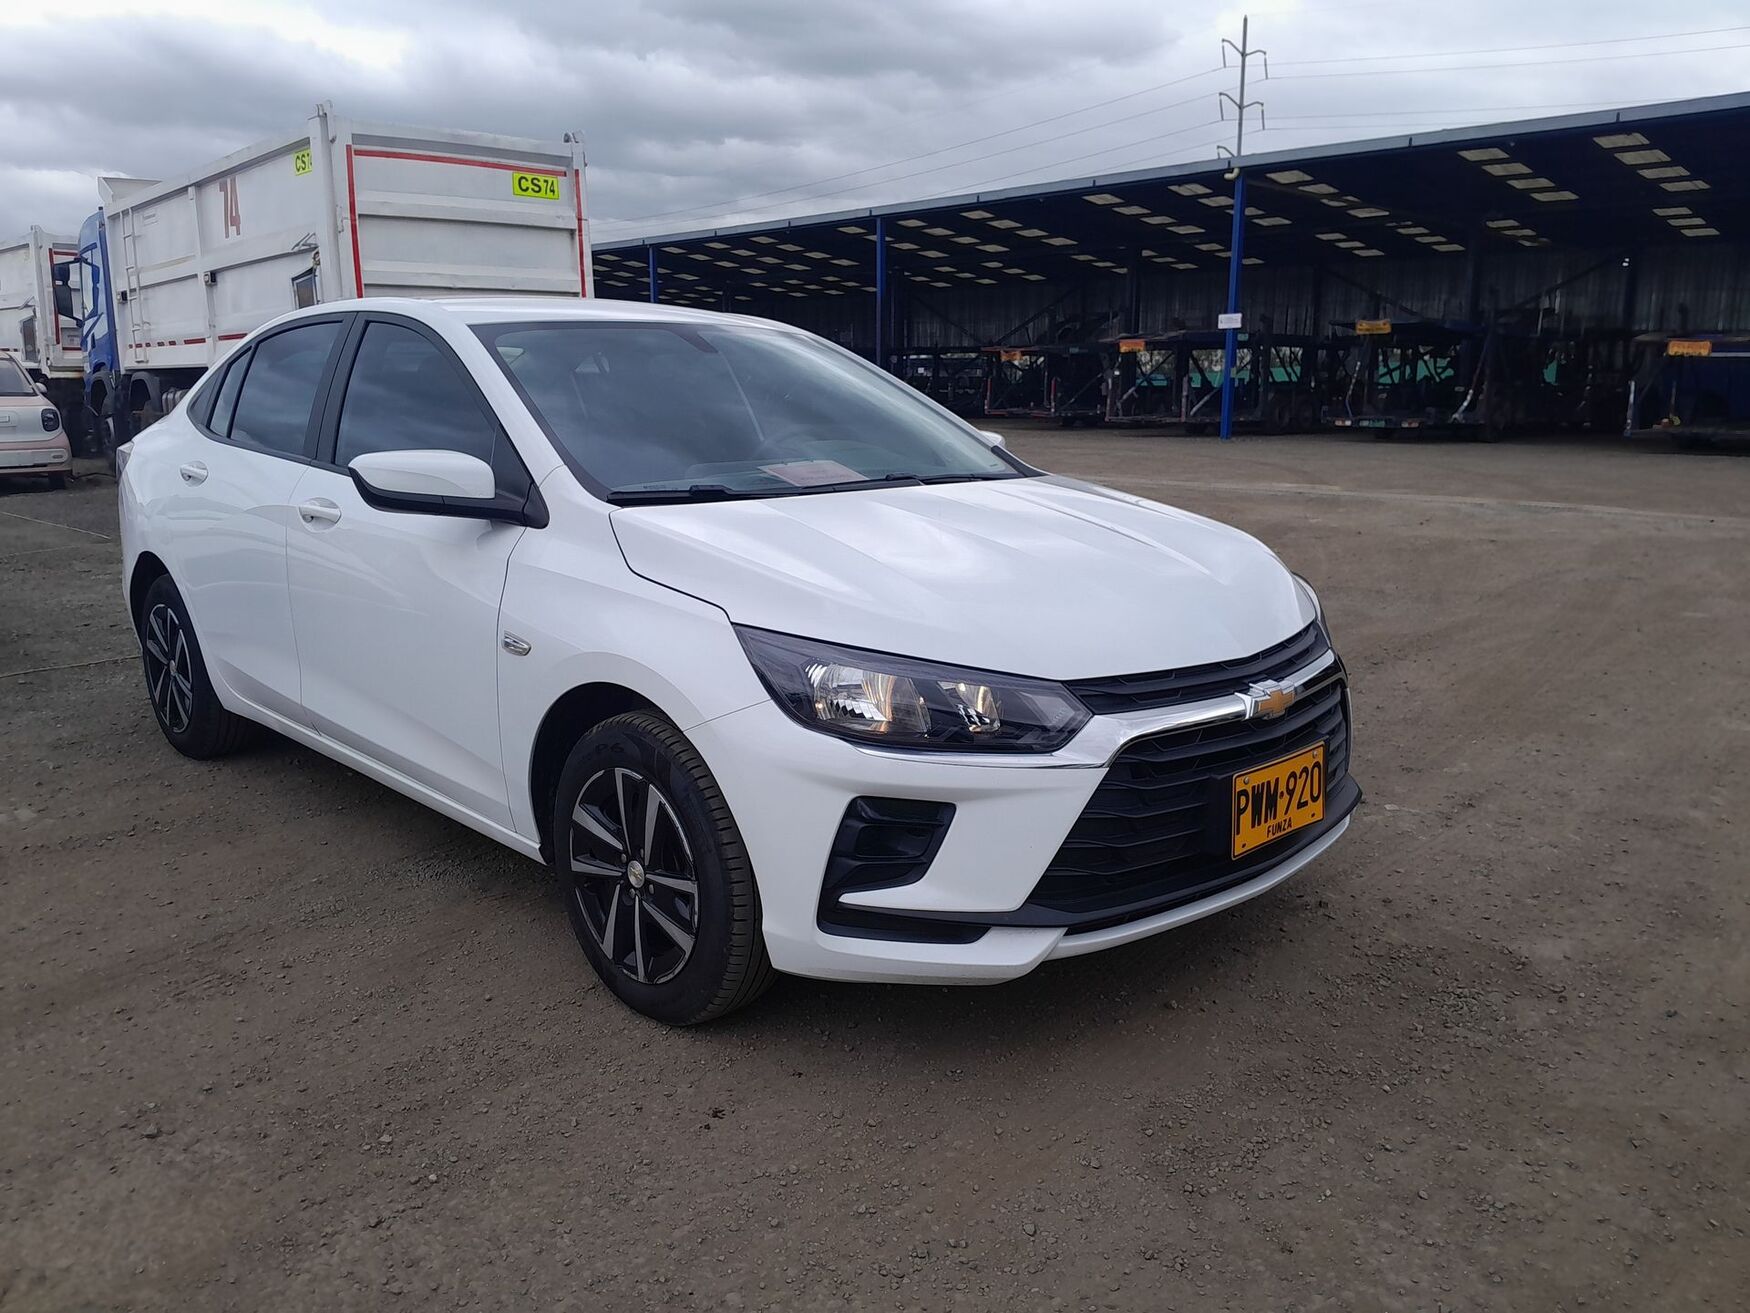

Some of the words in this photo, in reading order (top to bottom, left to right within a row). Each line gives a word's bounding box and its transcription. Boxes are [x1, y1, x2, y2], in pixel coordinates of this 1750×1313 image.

[295, 152, 312, 173] CS7
[517, 175, 556, 196] CS74
[219, 175, 242, 239] 74
[1266, 816, 1293, 838] FUNZA
